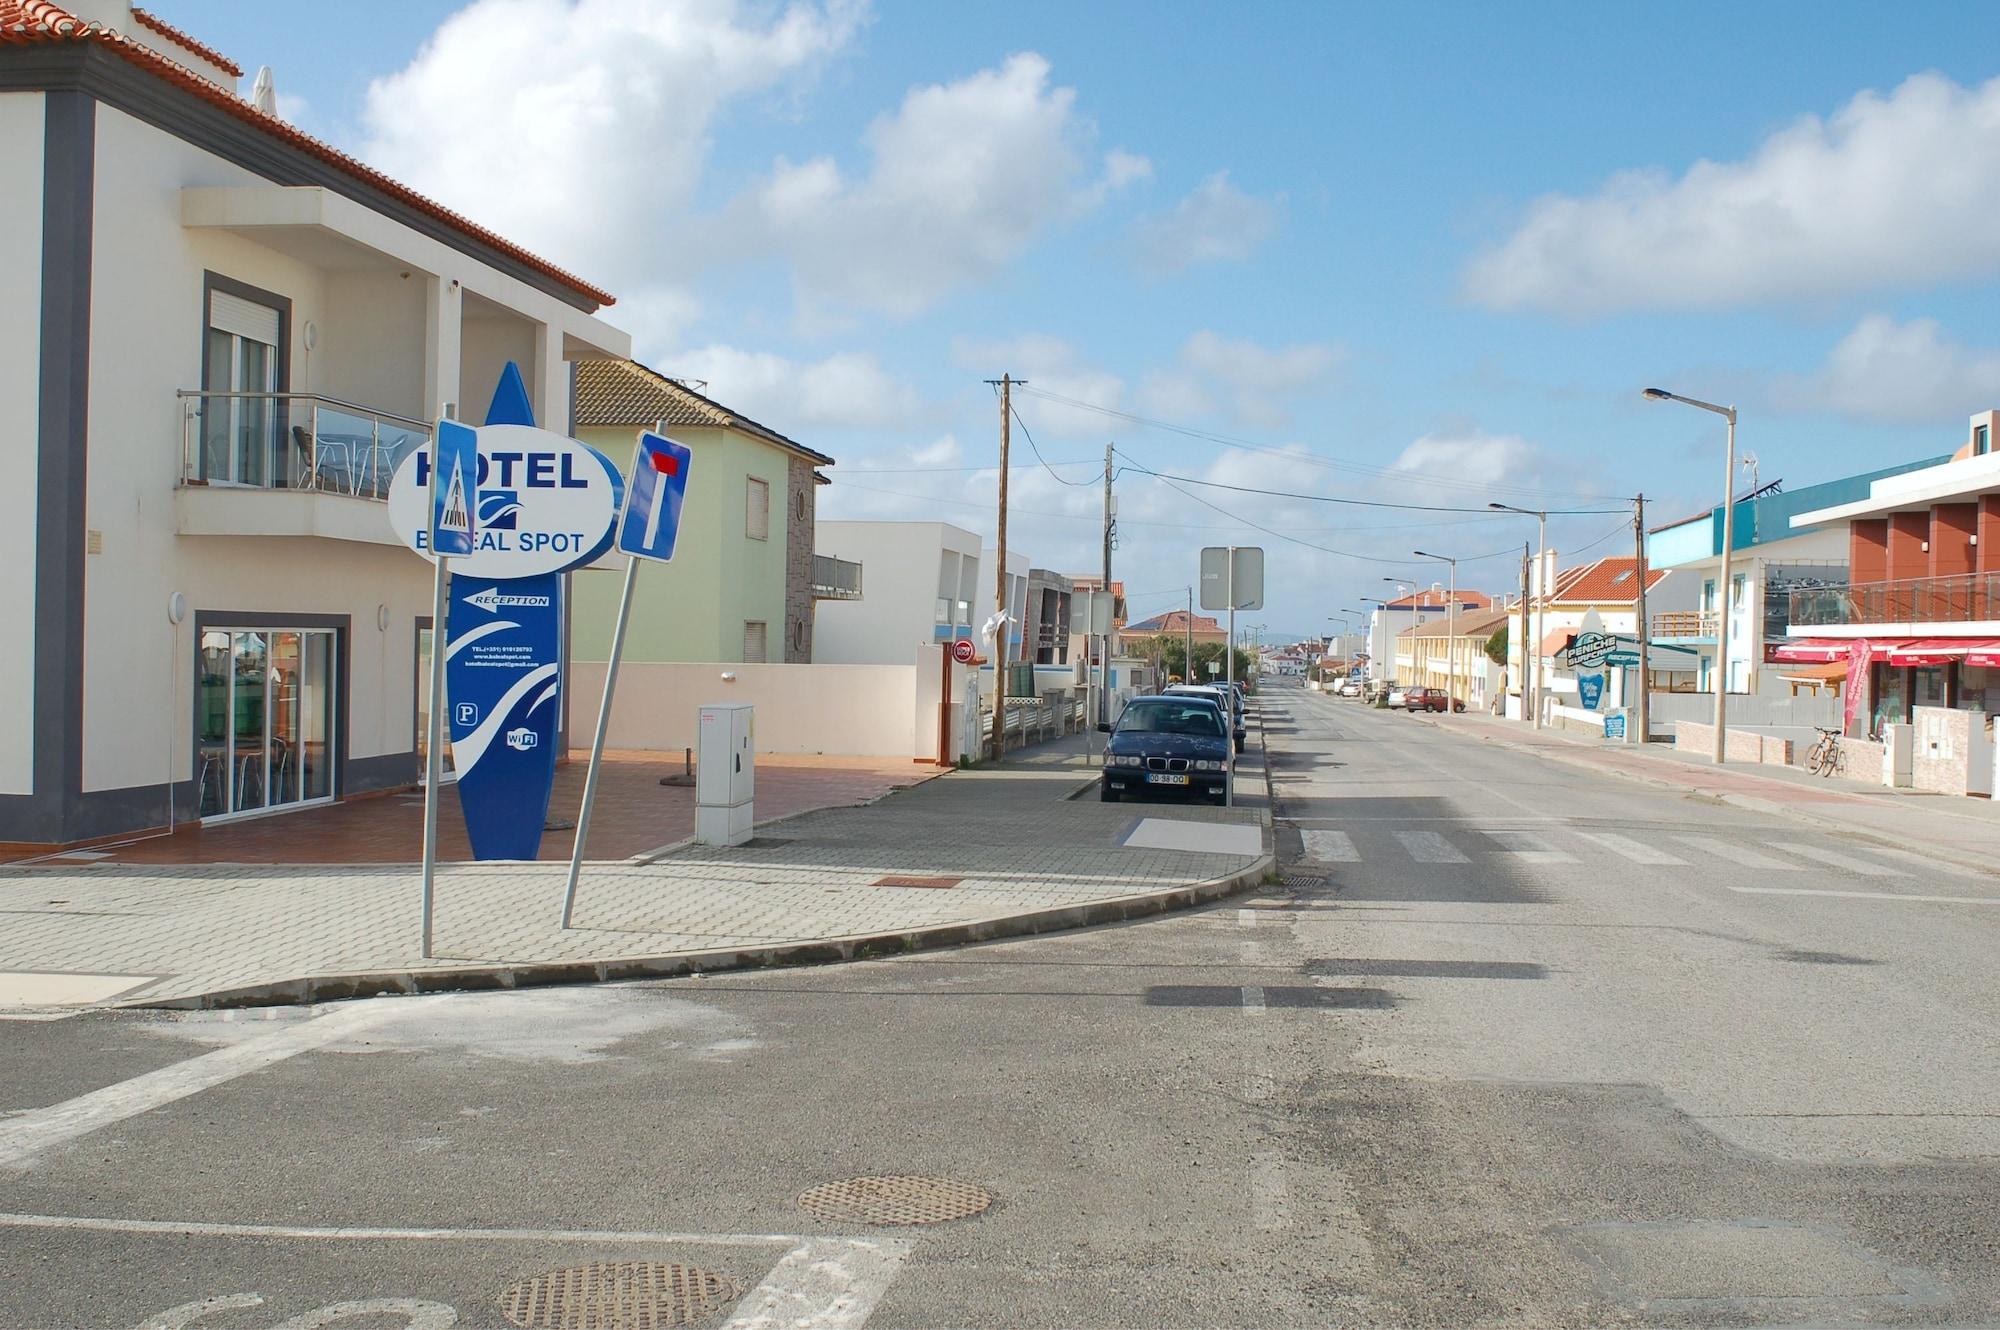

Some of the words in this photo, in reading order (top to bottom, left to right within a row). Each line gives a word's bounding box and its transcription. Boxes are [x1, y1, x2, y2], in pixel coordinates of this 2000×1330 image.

[416, 531, 511, 551] BAL
[519, 533, 584, 552] SPOT
[475, 596, 548, 605] RECEPTION
[1568, 636, 1616, 658] PENICHE
[1568, 645, 1616, 665] SURFCAMP
[460, 706, 473, 722] P
